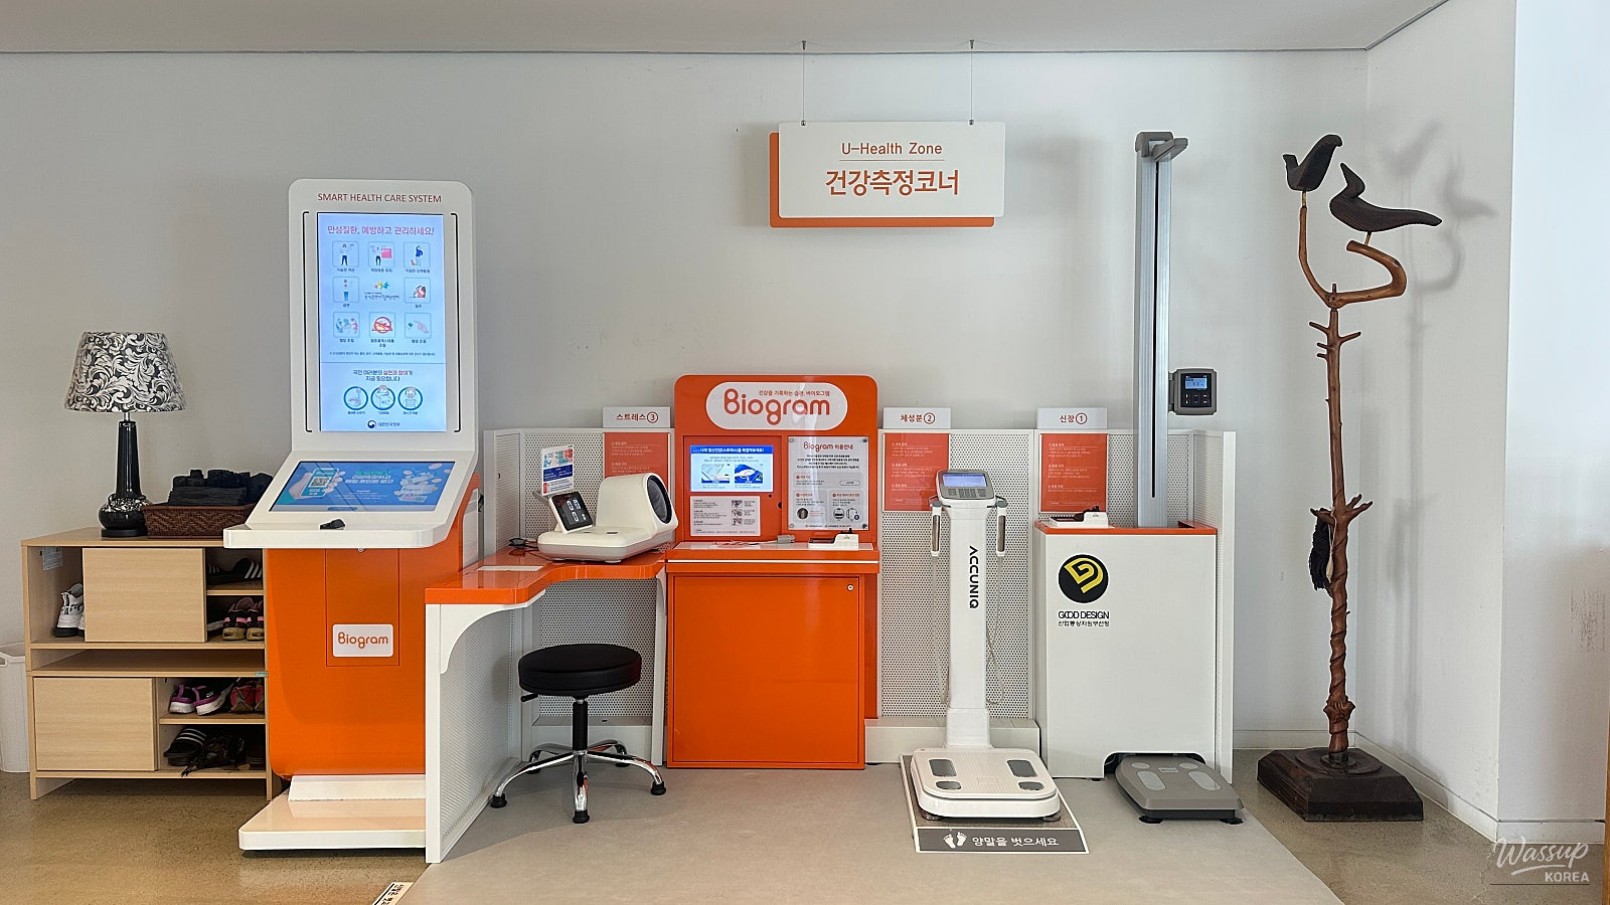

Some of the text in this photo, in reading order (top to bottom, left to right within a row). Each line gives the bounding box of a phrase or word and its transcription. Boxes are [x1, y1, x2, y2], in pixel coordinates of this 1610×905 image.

[841, 142, 942, 155] U-Health Zone
[825, 169, 959, 196] 건강측정코너
[317, 193, 442, 203] SMART HEALTH CARE SYSTEM
[361, 225, 392, 235] 예방하고
[394, 226, 434, 236] 관리하세요!
[724, 388, 830, 425] Biogram
[803, 441, 834, 452] Biogram
[969, 545, 979, 609] ACCUNIQ
[1058, 610, 1110, 619] GOOD DESIGN
[338, 631, 389, 649] Biogram
[972, 836, 1060, 847] 양말을 벗으세요
